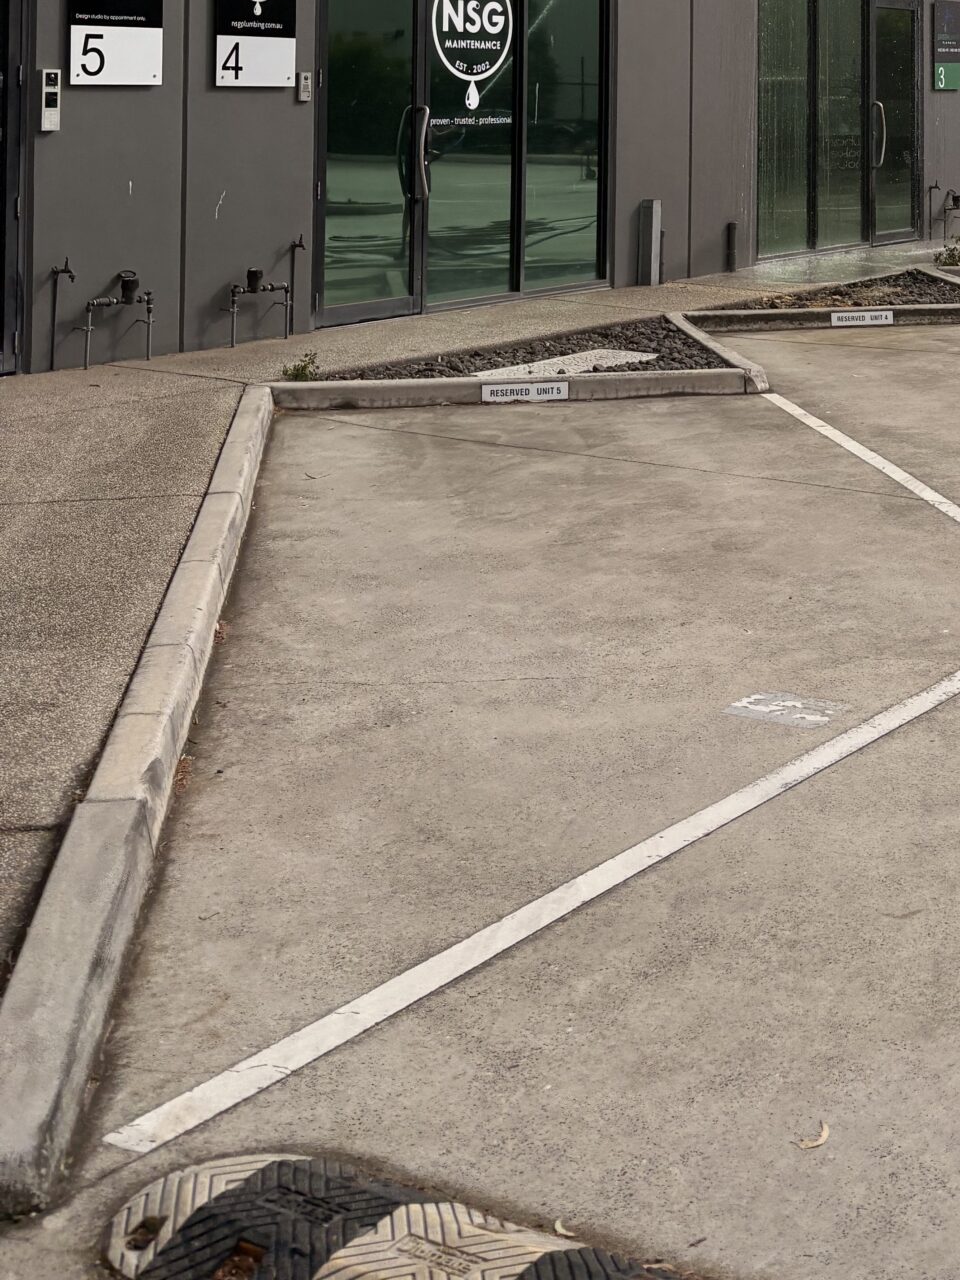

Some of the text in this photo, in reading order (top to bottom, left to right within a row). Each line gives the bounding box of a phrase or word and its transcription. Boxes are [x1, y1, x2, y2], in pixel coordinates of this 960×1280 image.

[444, 39, 501, 50] MAINTENANCE
[80, 33, 105, 77] 5
[221, 42, 243, 80] 4
[473, 61, 491, 73] 2002
[938, 66, 945, 88] 3
[430, 118, 450, 127] proven
[455, 116, 475, 125] trusted
[479, 115, 512, 125] professional
[490, 386, 561, 397] RESERVED UNIT 5
